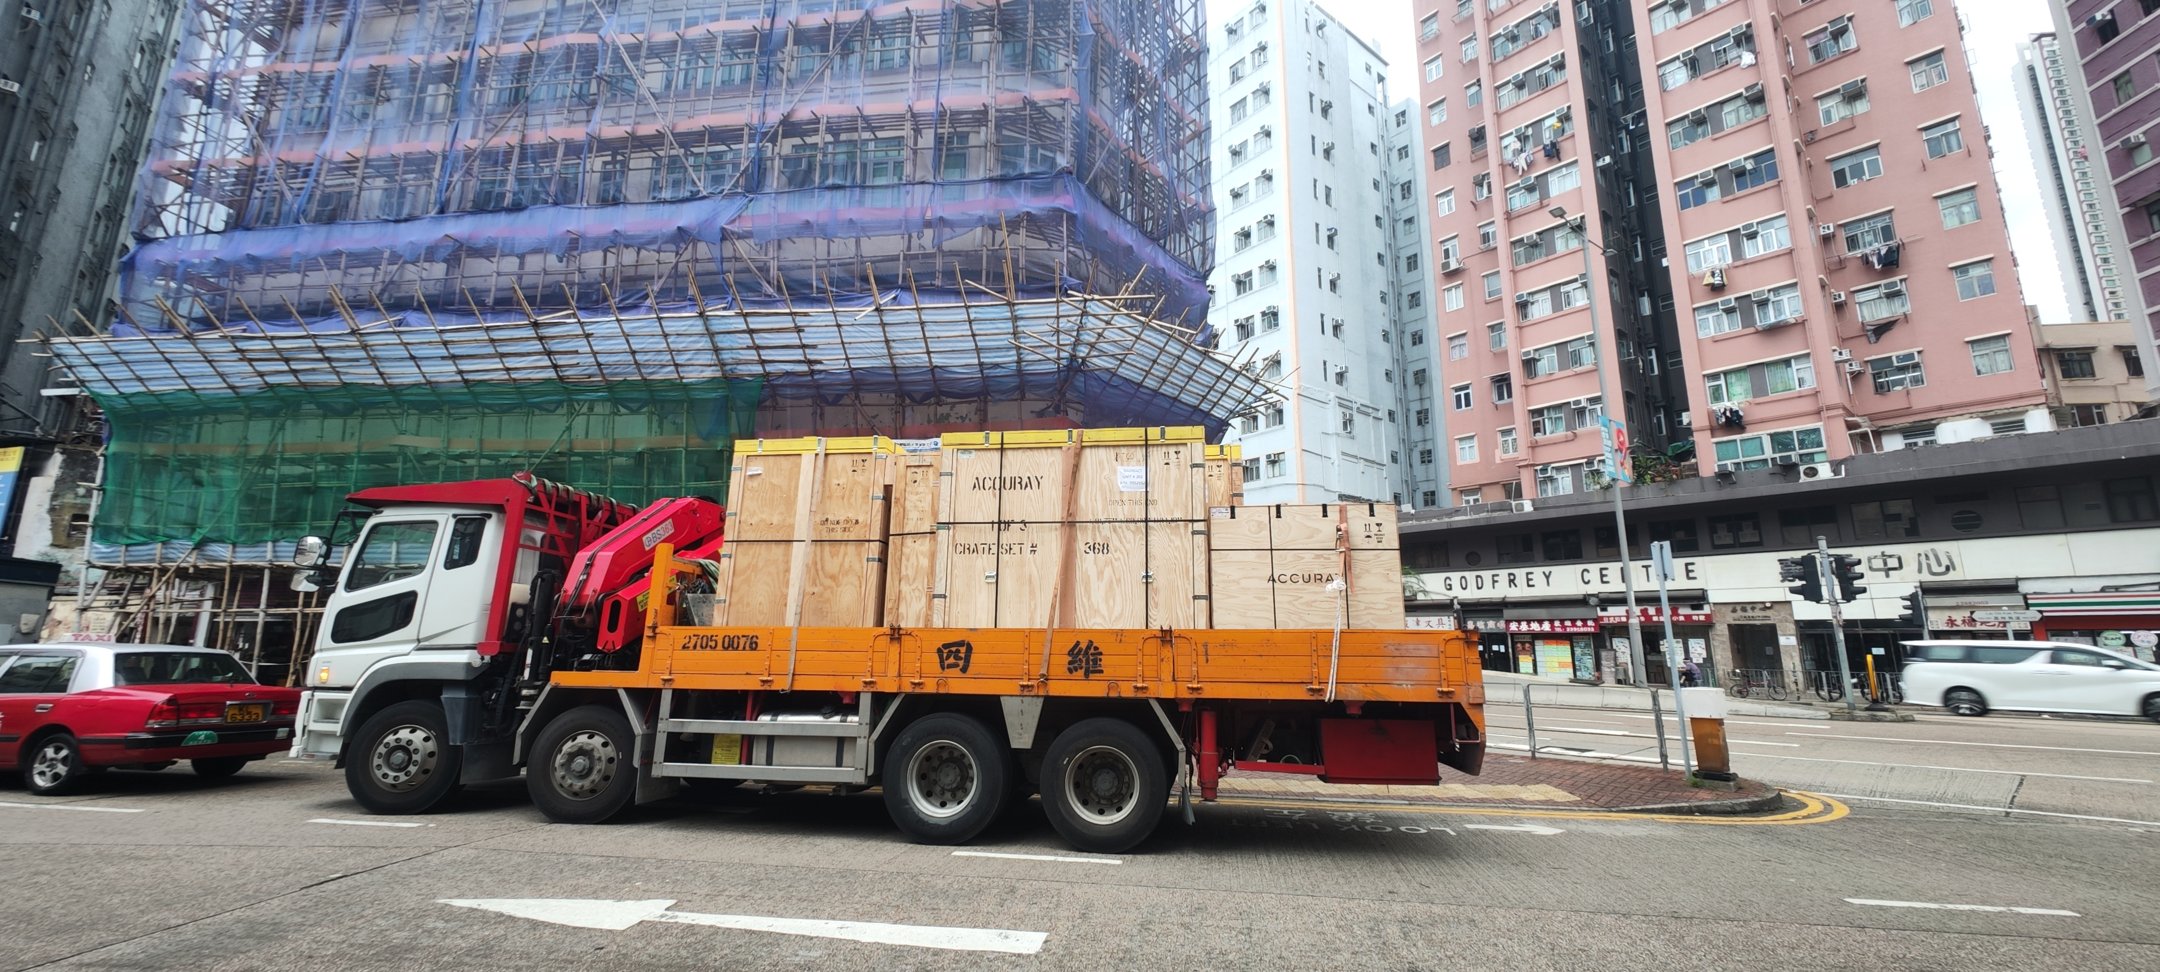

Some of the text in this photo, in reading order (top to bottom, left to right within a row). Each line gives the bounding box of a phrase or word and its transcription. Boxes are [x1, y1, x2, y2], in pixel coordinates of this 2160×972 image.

[972, 475, 1044, 491] ACCURAY
[955, 541, 1110, 555] CRATE SET # 368
[1443, 562, 1698, 592] GODFREY CETE
[71, 633, 113, 642] TAXI
[682, 634, 759, 650] 2705 0076
[1338, 825, 1457, 836] LOOK
